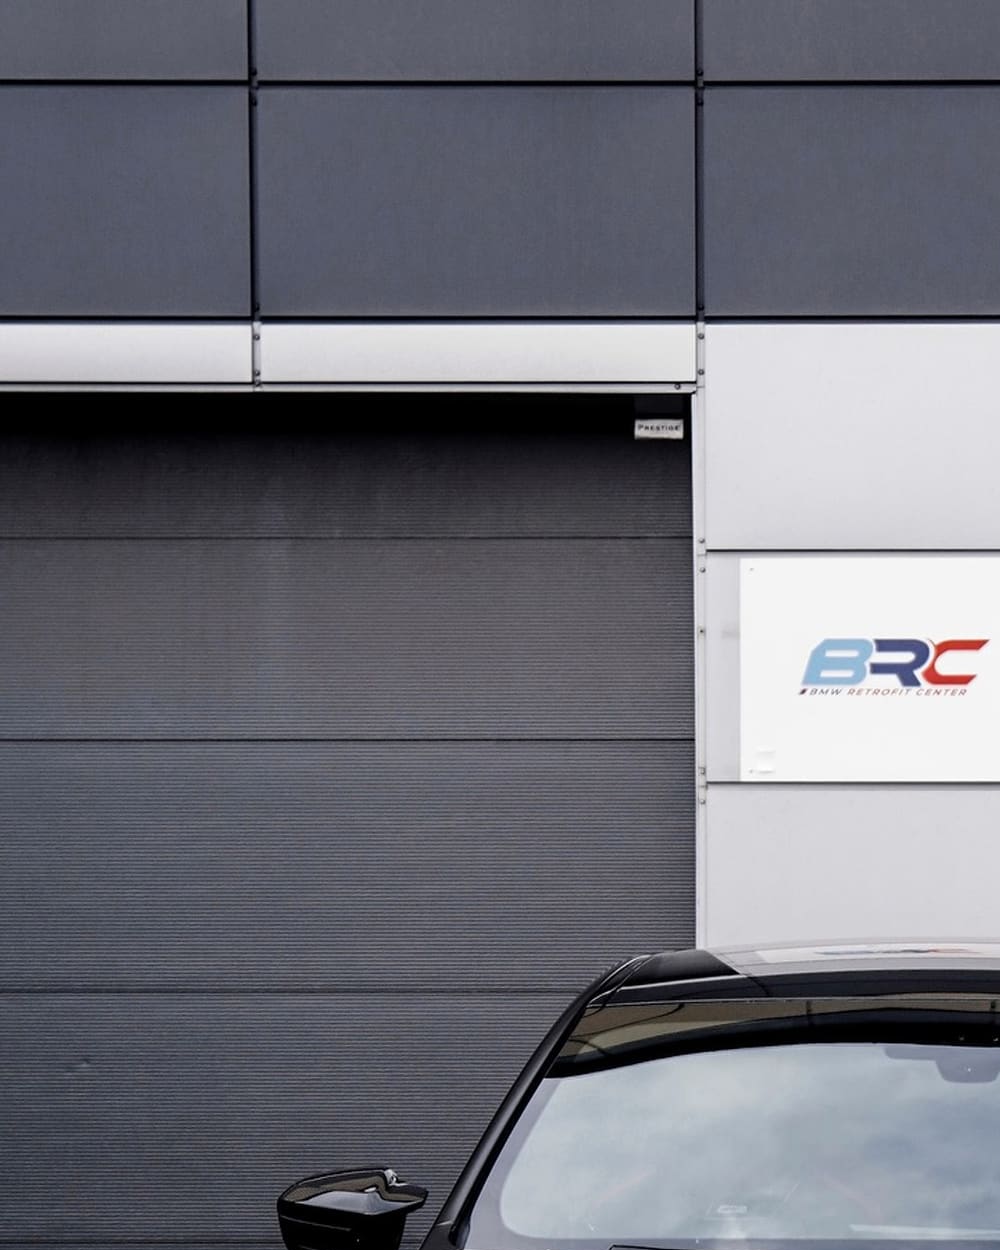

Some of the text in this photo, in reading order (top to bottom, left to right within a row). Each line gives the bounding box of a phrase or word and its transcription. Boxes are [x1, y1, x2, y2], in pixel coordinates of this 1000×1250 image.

[801, 638, 990, 687] BRC
[809, 688, 968, 696] BMW RETROFIT CENTER
